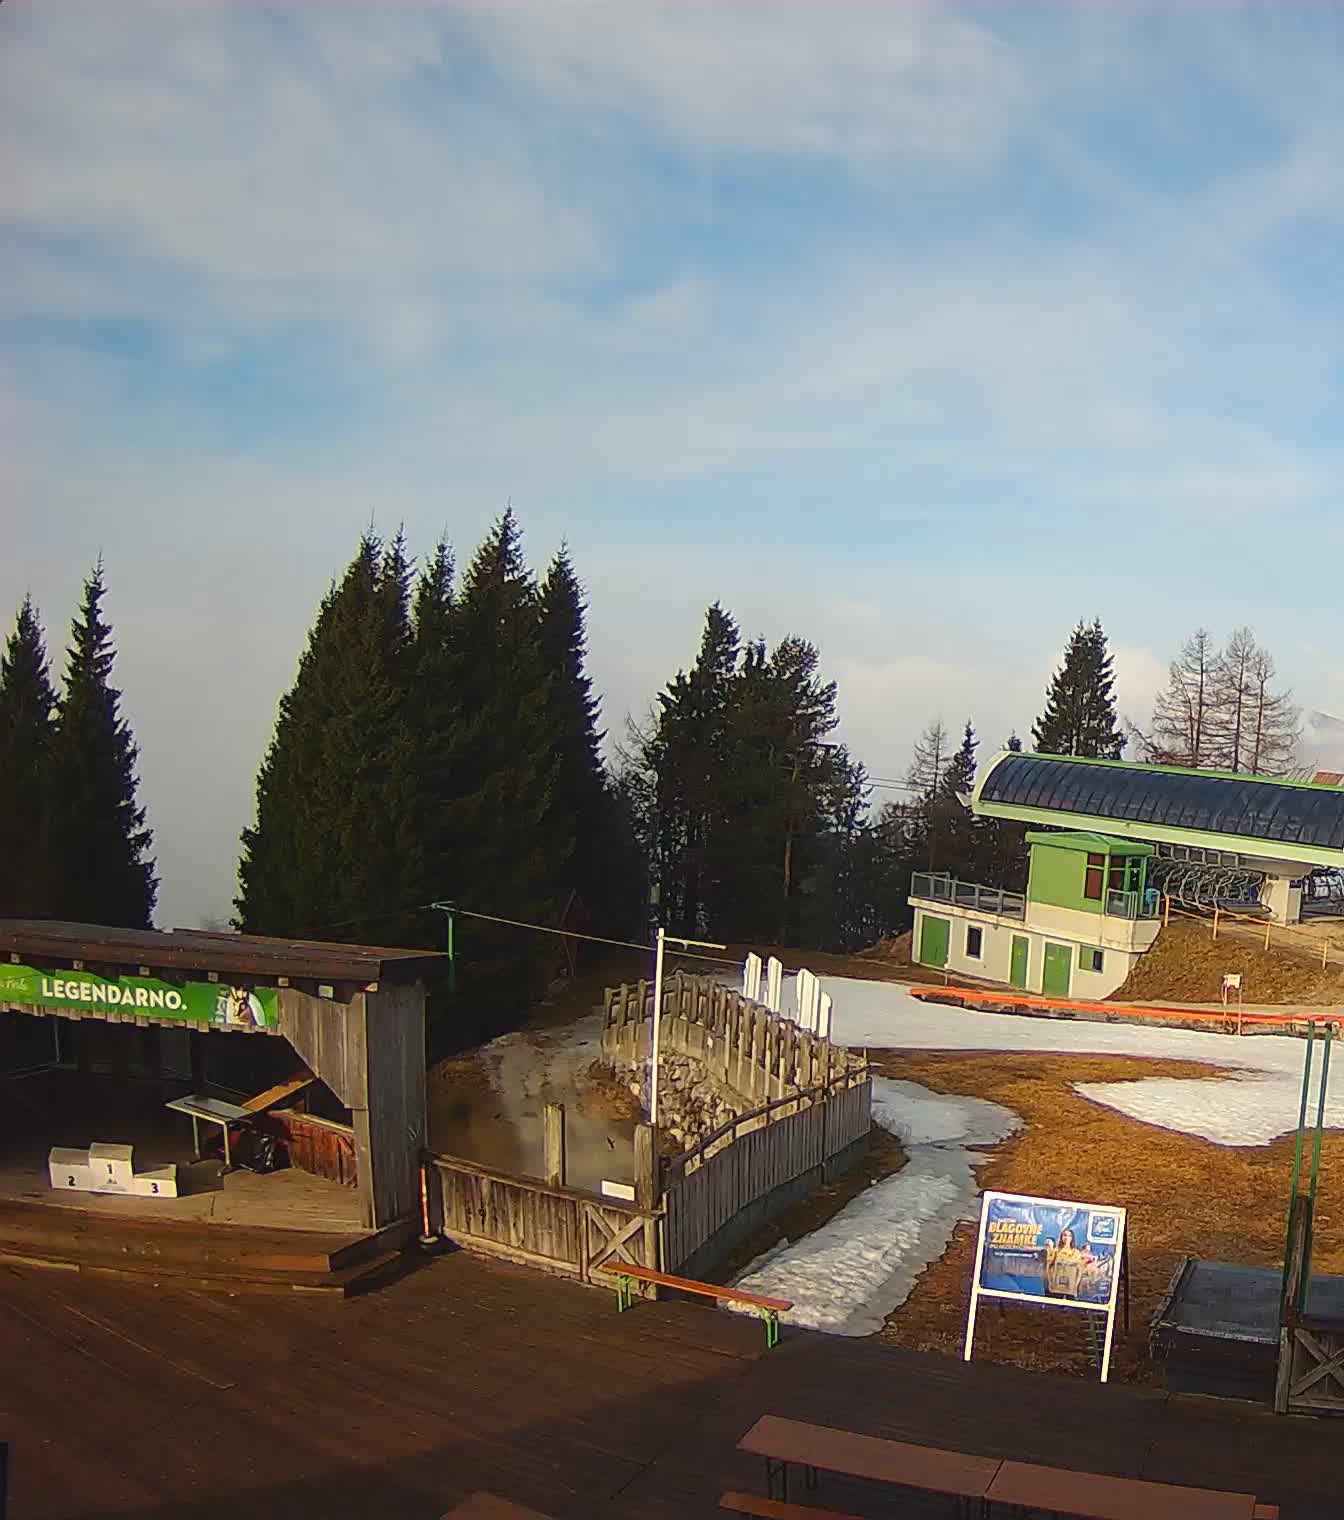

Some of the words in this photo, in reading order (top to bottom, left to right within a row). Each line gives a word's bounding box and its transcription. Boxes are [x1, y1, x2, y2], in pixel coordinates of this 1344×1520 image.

[42, 977, 187, 1010] LEGENDARNO.
[107, 1163, 113, 1175] 1
[68, 1175, 76, 1187] 2
[151, 1182, 160, 1194] 3
[991, 1232, 1037, 1245] ZNAMKE
